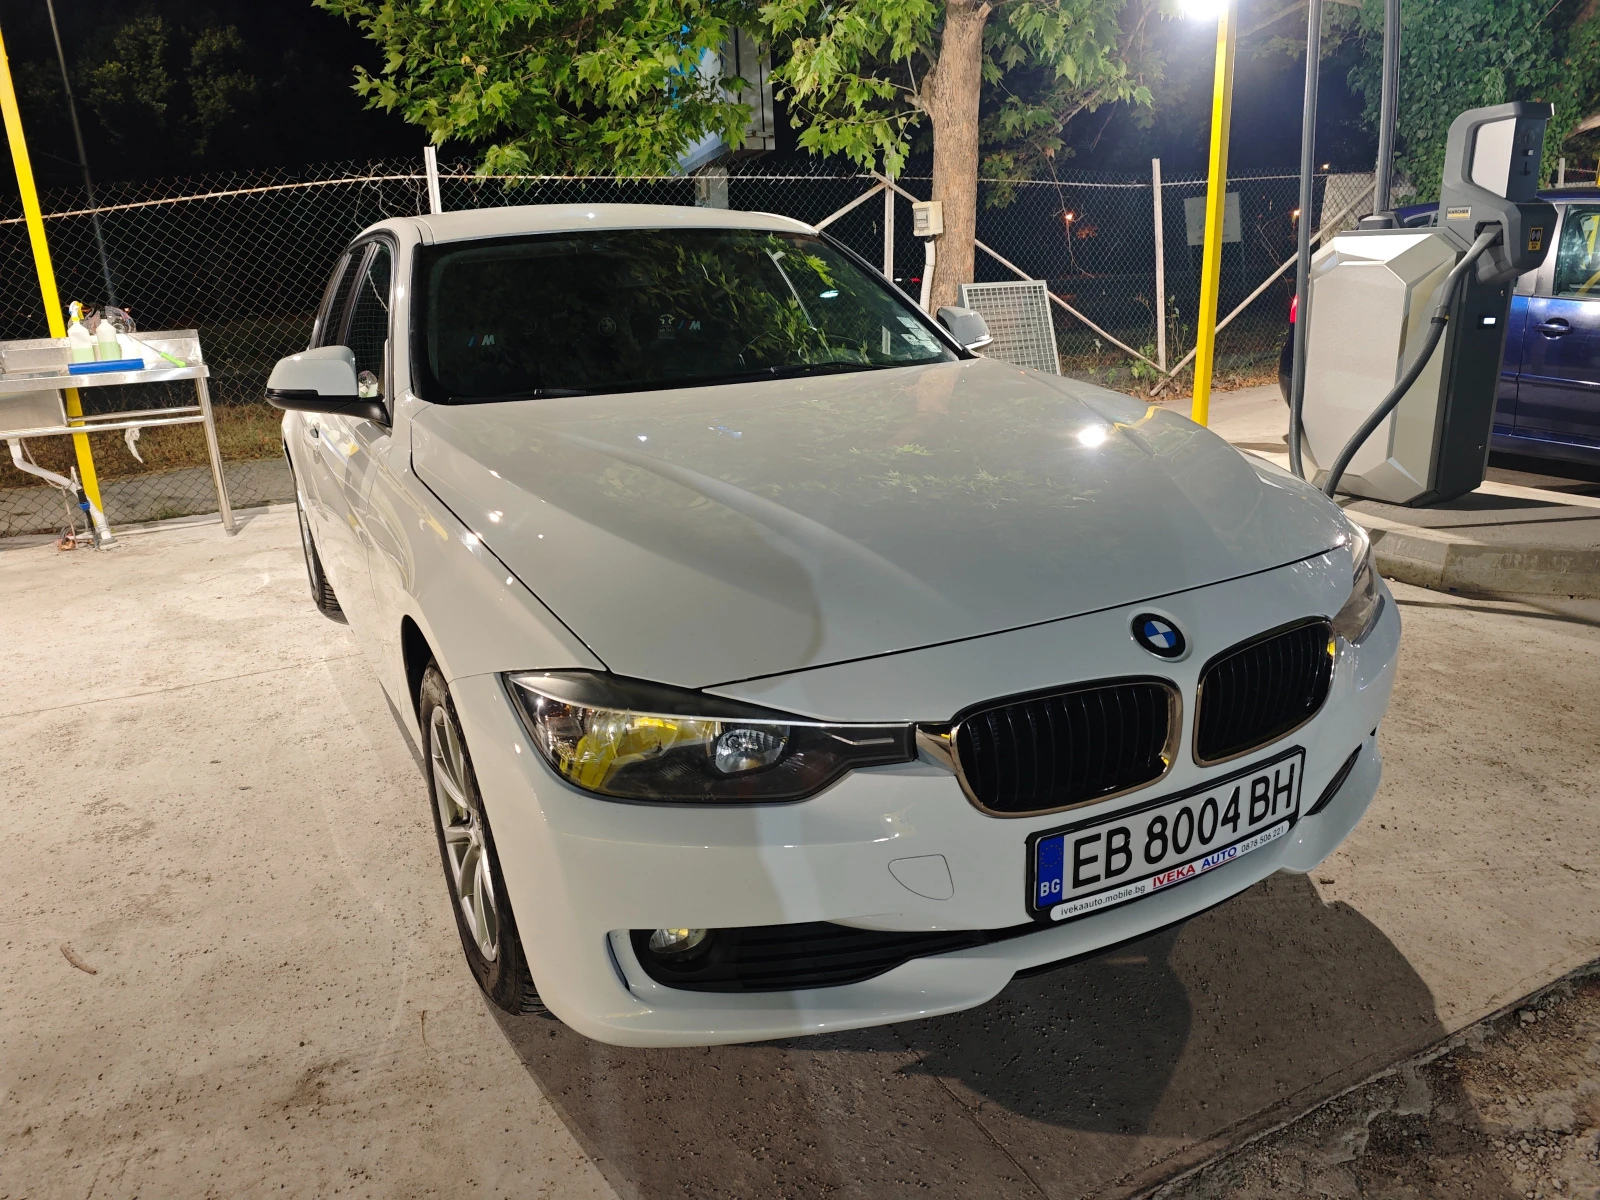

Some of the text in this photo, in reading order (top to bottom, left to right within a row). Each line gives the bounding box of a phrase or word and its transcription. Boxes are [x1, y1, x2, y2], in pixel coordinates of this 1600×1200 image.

[1060, 826, 1285, 916] ivekaauto.mobile.bg IVEKA AUTO 0878 506 221
[1072, 763, 1295, 889] EB 8004 BH
[1040, 878, 1060, 897] BG
